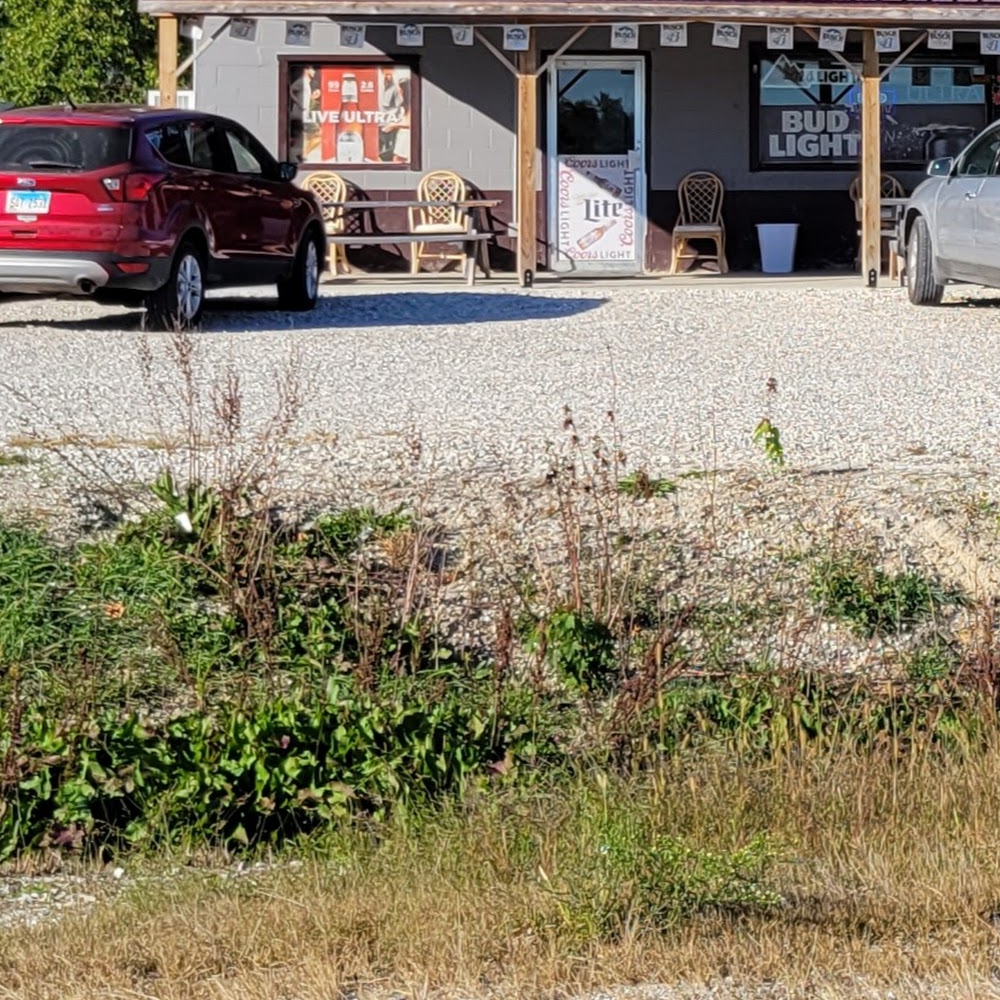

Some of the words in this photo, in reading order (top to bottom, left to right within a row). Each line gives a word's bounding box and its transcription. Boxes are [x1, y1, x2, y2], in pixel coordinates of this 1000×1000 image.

[302, 110, 340, 123] LIVE
[344, 110, 401, 123] ULTRA
[781, 110, 850, 133] BUD
[768, 134, 862, 158] LIGHT
[565, 156, 598, 168] Coors
[560, 170, 574, 208] Coors
[623, 170, 635, 206] LIGHT
[584, 199, 623, 222] Lite
[560, 211, 570, 247] LIGHT
[619, 207, 634, 247] Coors
[565, 246, 598, 259] Coors
[600, 251, 631, 259] LIGHT
